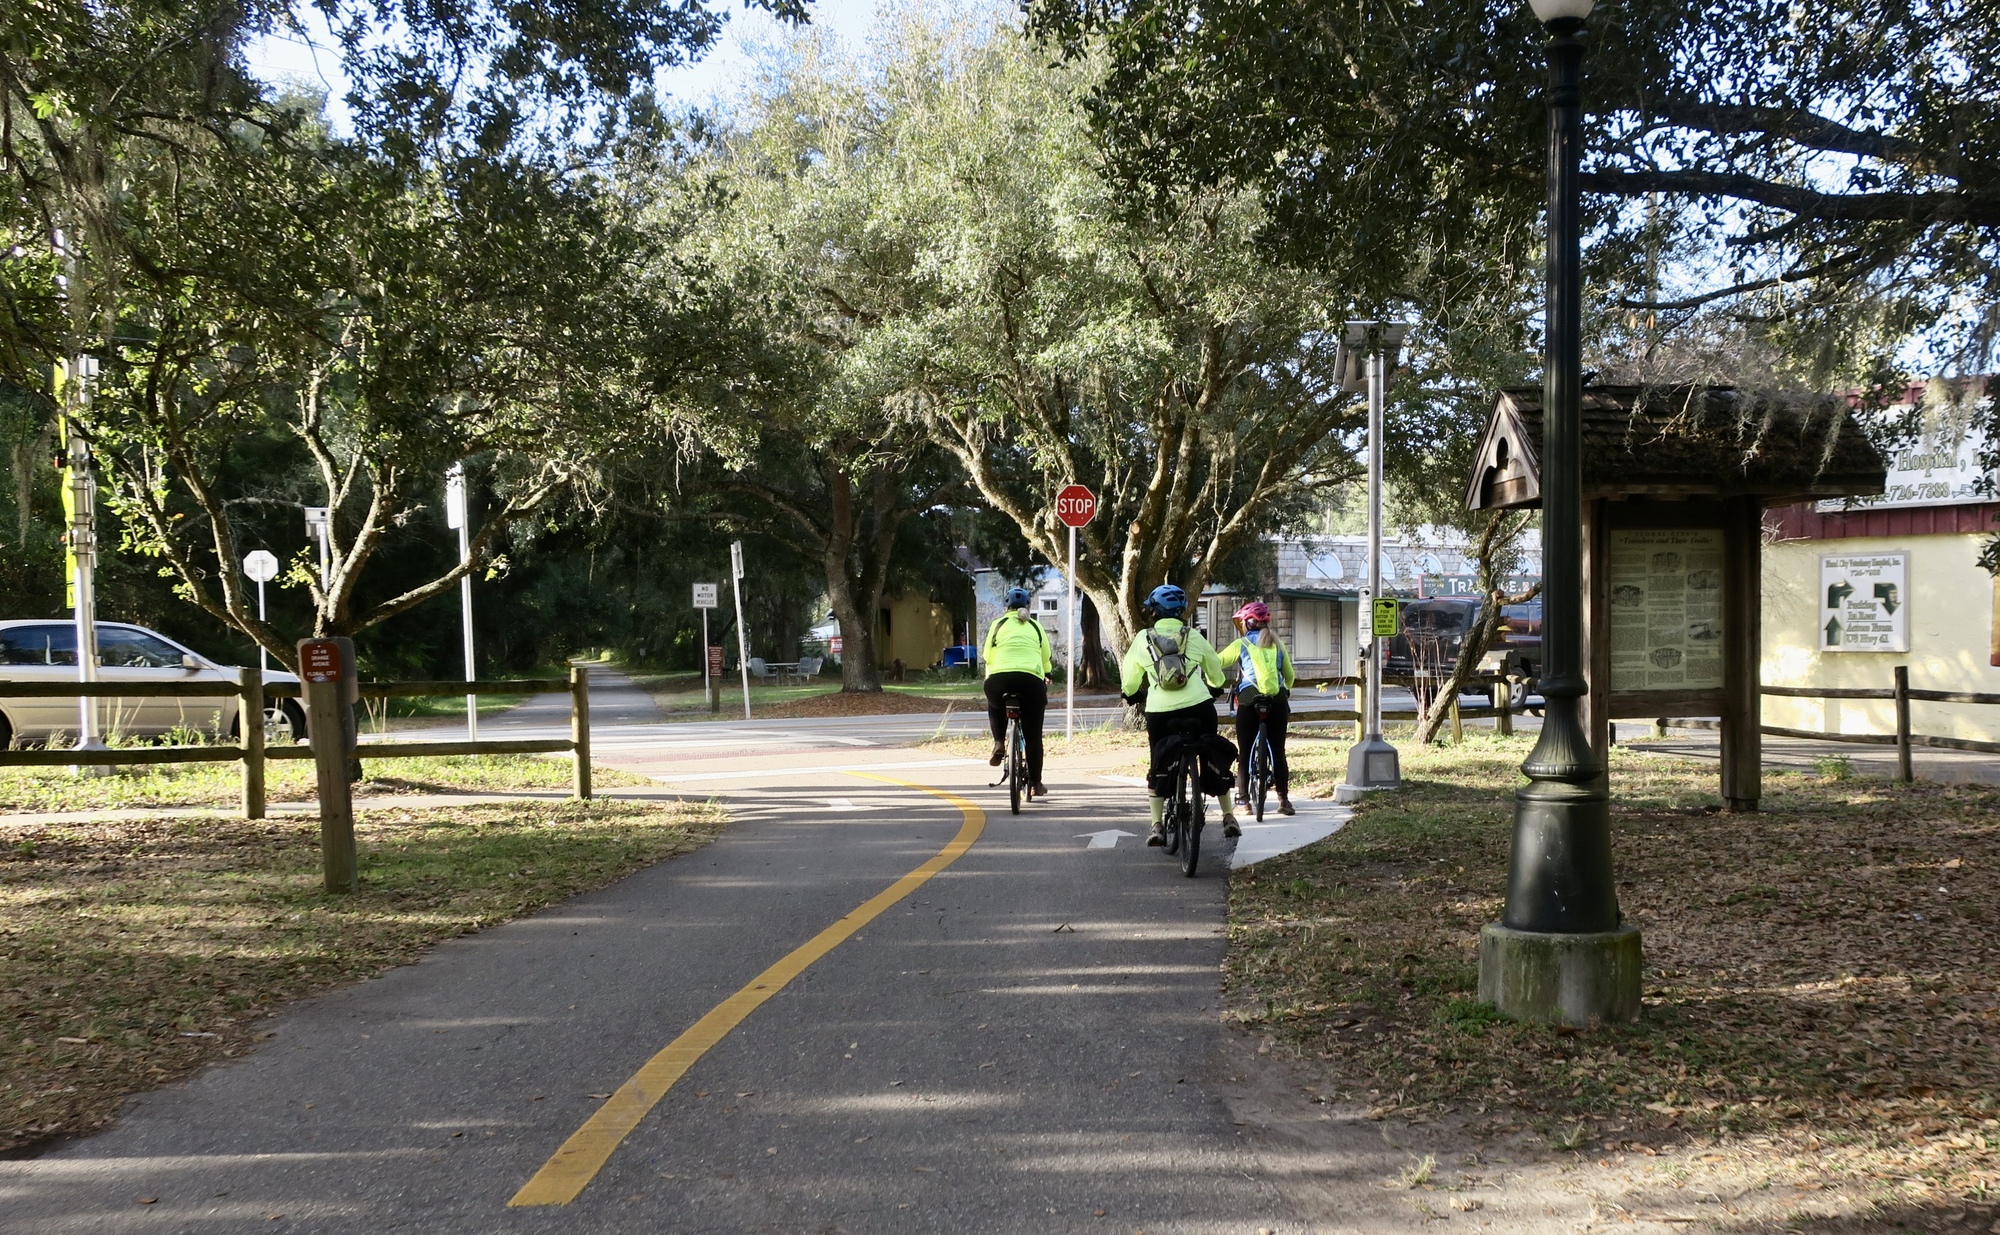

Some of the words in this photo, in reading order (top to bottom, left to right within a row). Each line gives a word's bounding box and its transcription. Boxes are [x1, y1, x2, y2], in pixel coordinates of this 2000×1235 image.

[1059, 498, 1092, 514] STOP
[1847, 600, 1877, 611] Parking
[1848, 611, 1857, 620] In
[1858, 611, 1876, 620] Rear
